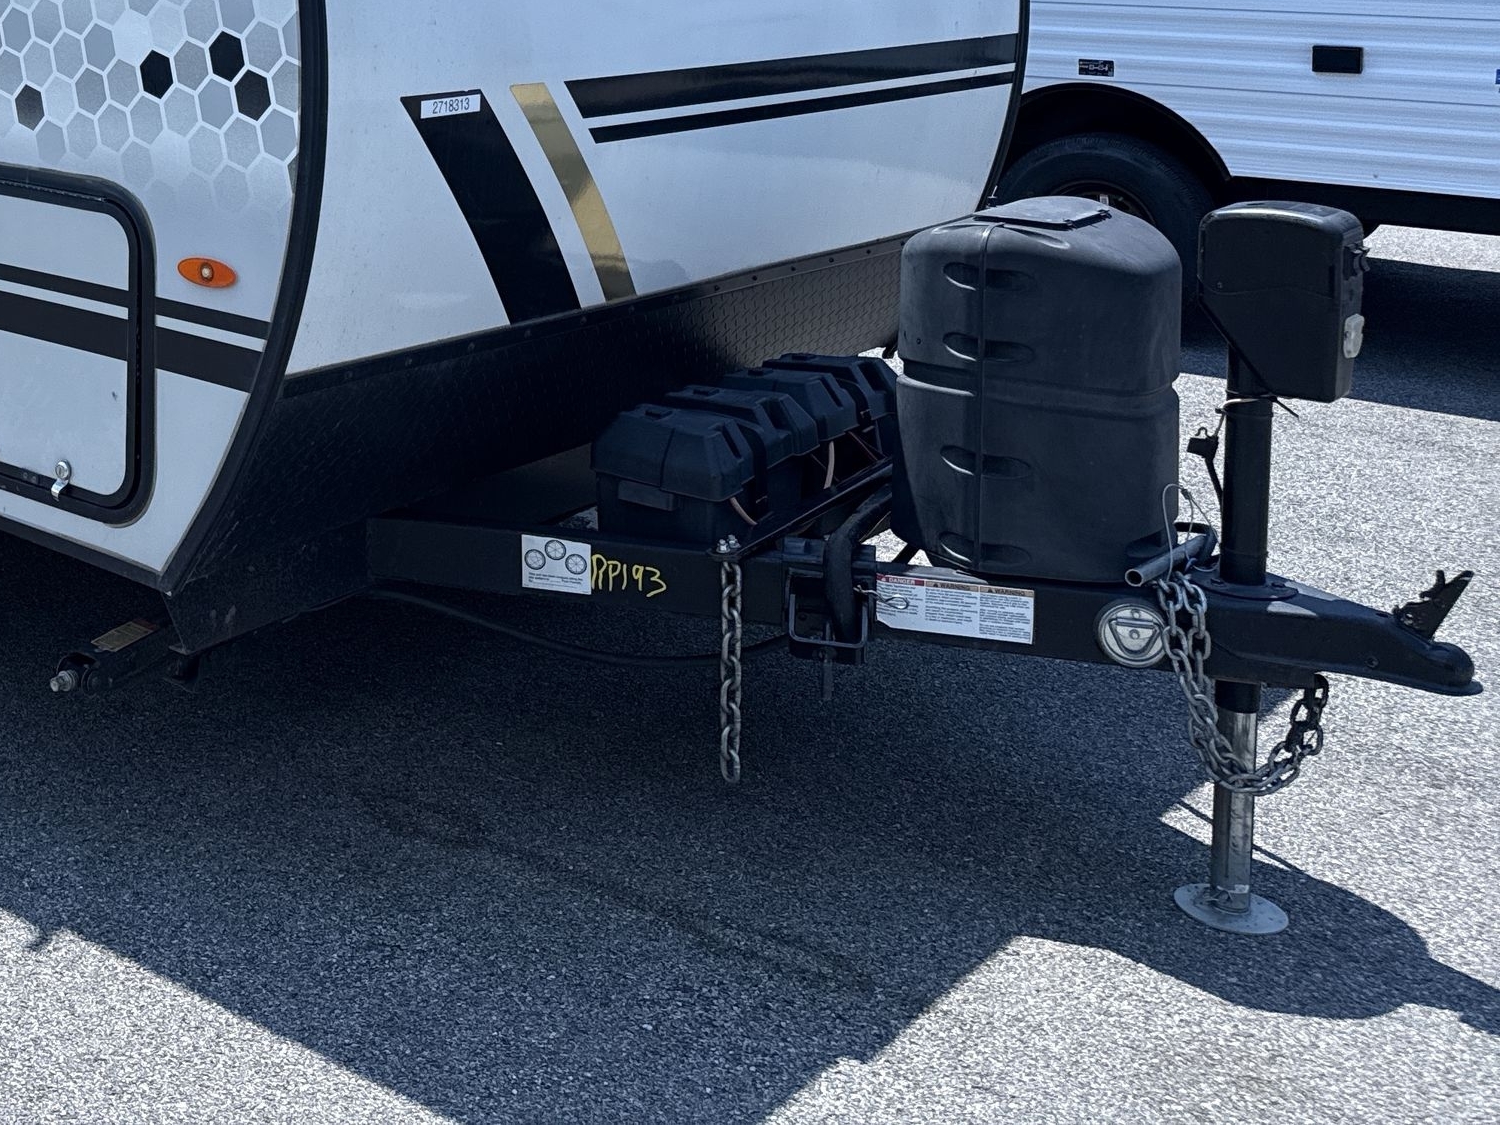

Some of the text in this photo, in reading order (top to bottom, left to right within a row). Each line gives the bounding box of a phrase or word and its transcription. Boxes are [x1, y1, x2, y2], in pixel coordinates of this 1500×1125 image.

[432, 97, 470, 114] 2718313
[888, 577, 916, 586] DANGER
[940, 583, 971, 591] WARNING
[995, 588, 1026, 597] WARNING
